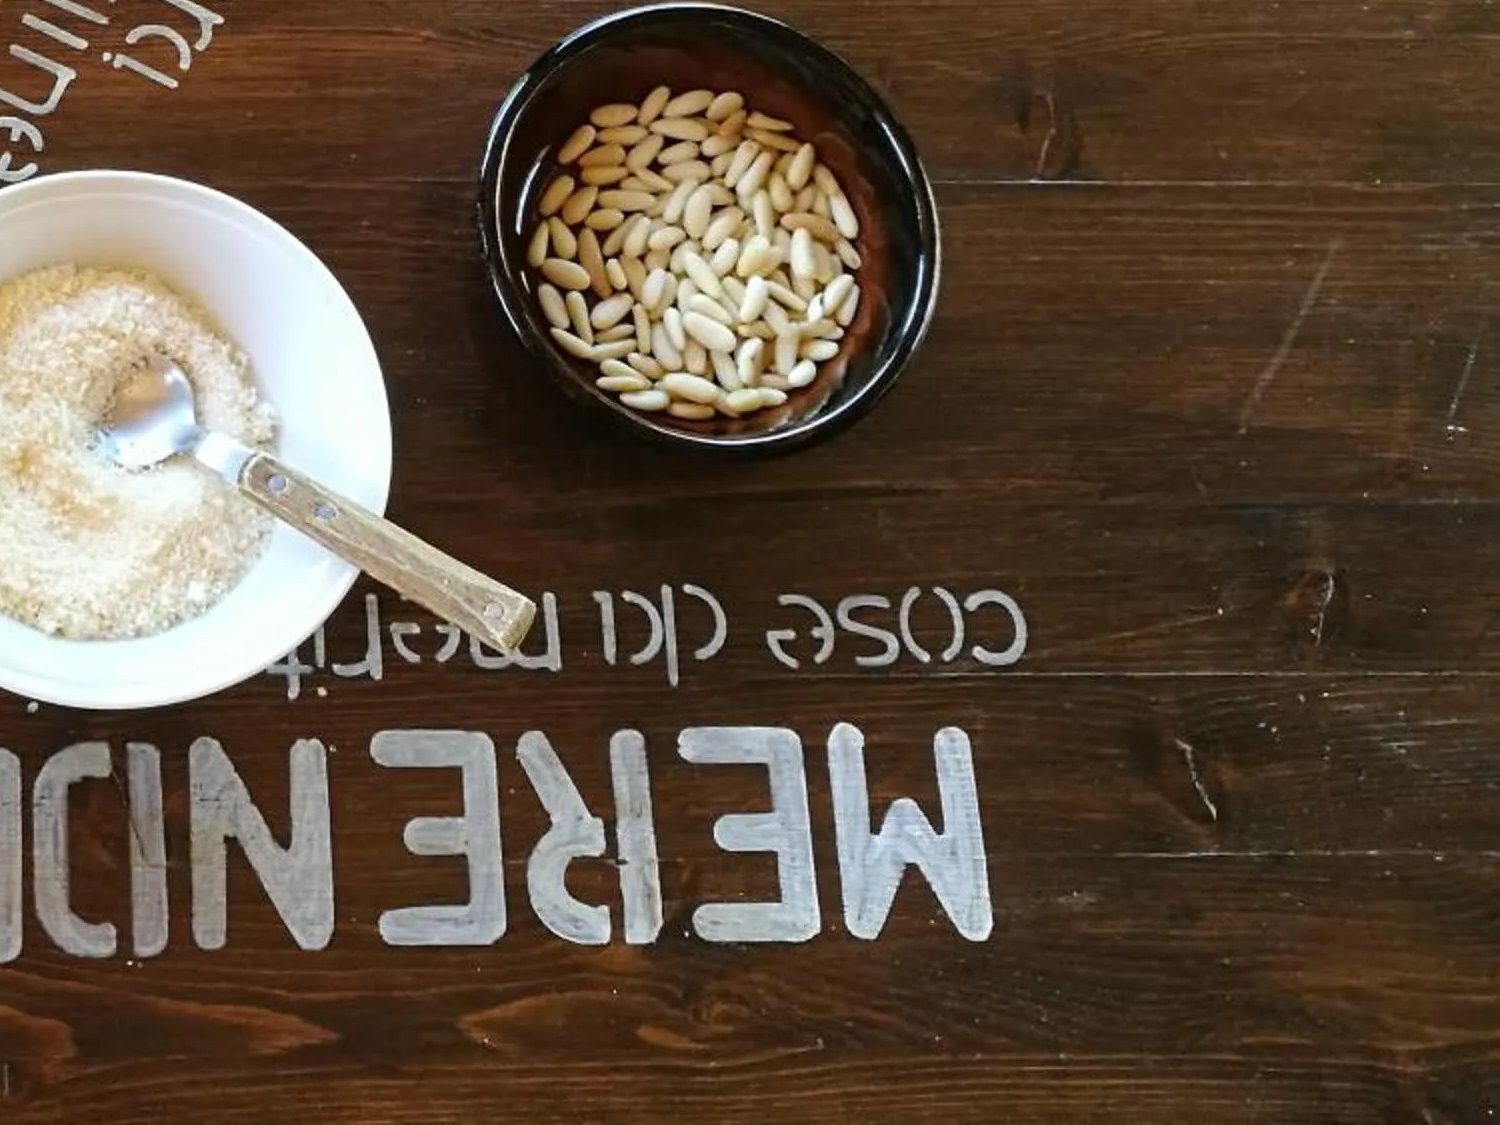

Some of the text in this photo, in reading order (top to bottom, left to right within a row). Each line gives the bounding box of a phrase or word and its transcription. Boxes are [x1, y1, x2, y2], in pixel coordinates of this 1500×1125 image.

[265, 583, 1028, 702] cose da merit
